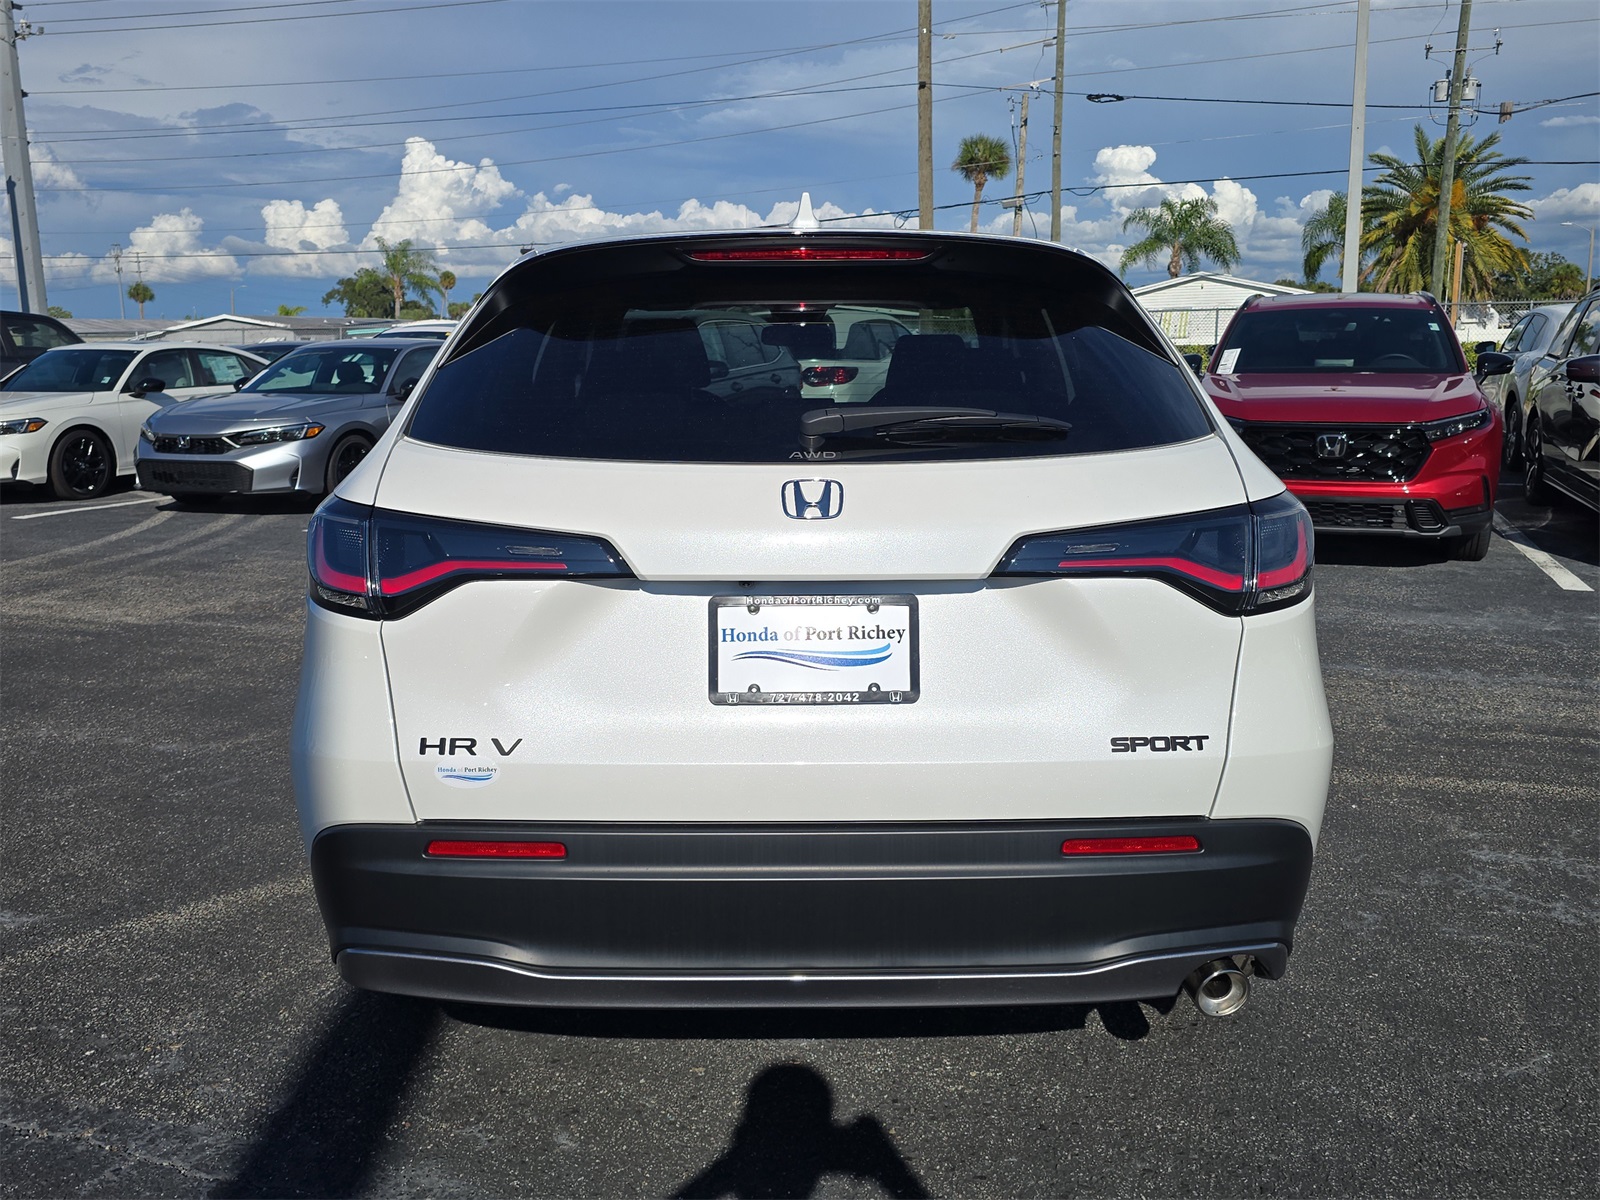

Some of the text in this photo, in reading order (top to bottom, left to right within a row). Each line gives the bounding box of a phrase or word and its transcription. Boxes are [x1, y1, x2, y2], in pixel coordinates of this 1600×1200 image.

[789, 451, 837, 459] AWD
[745, 595, 881, 605] HondaofPortRichey.com
[721, 624, 906, 643] Honda of Port Richey
[769, 692, 860, 703] 727-478-2042
[1110, 735, 1210, 752] SPORT
